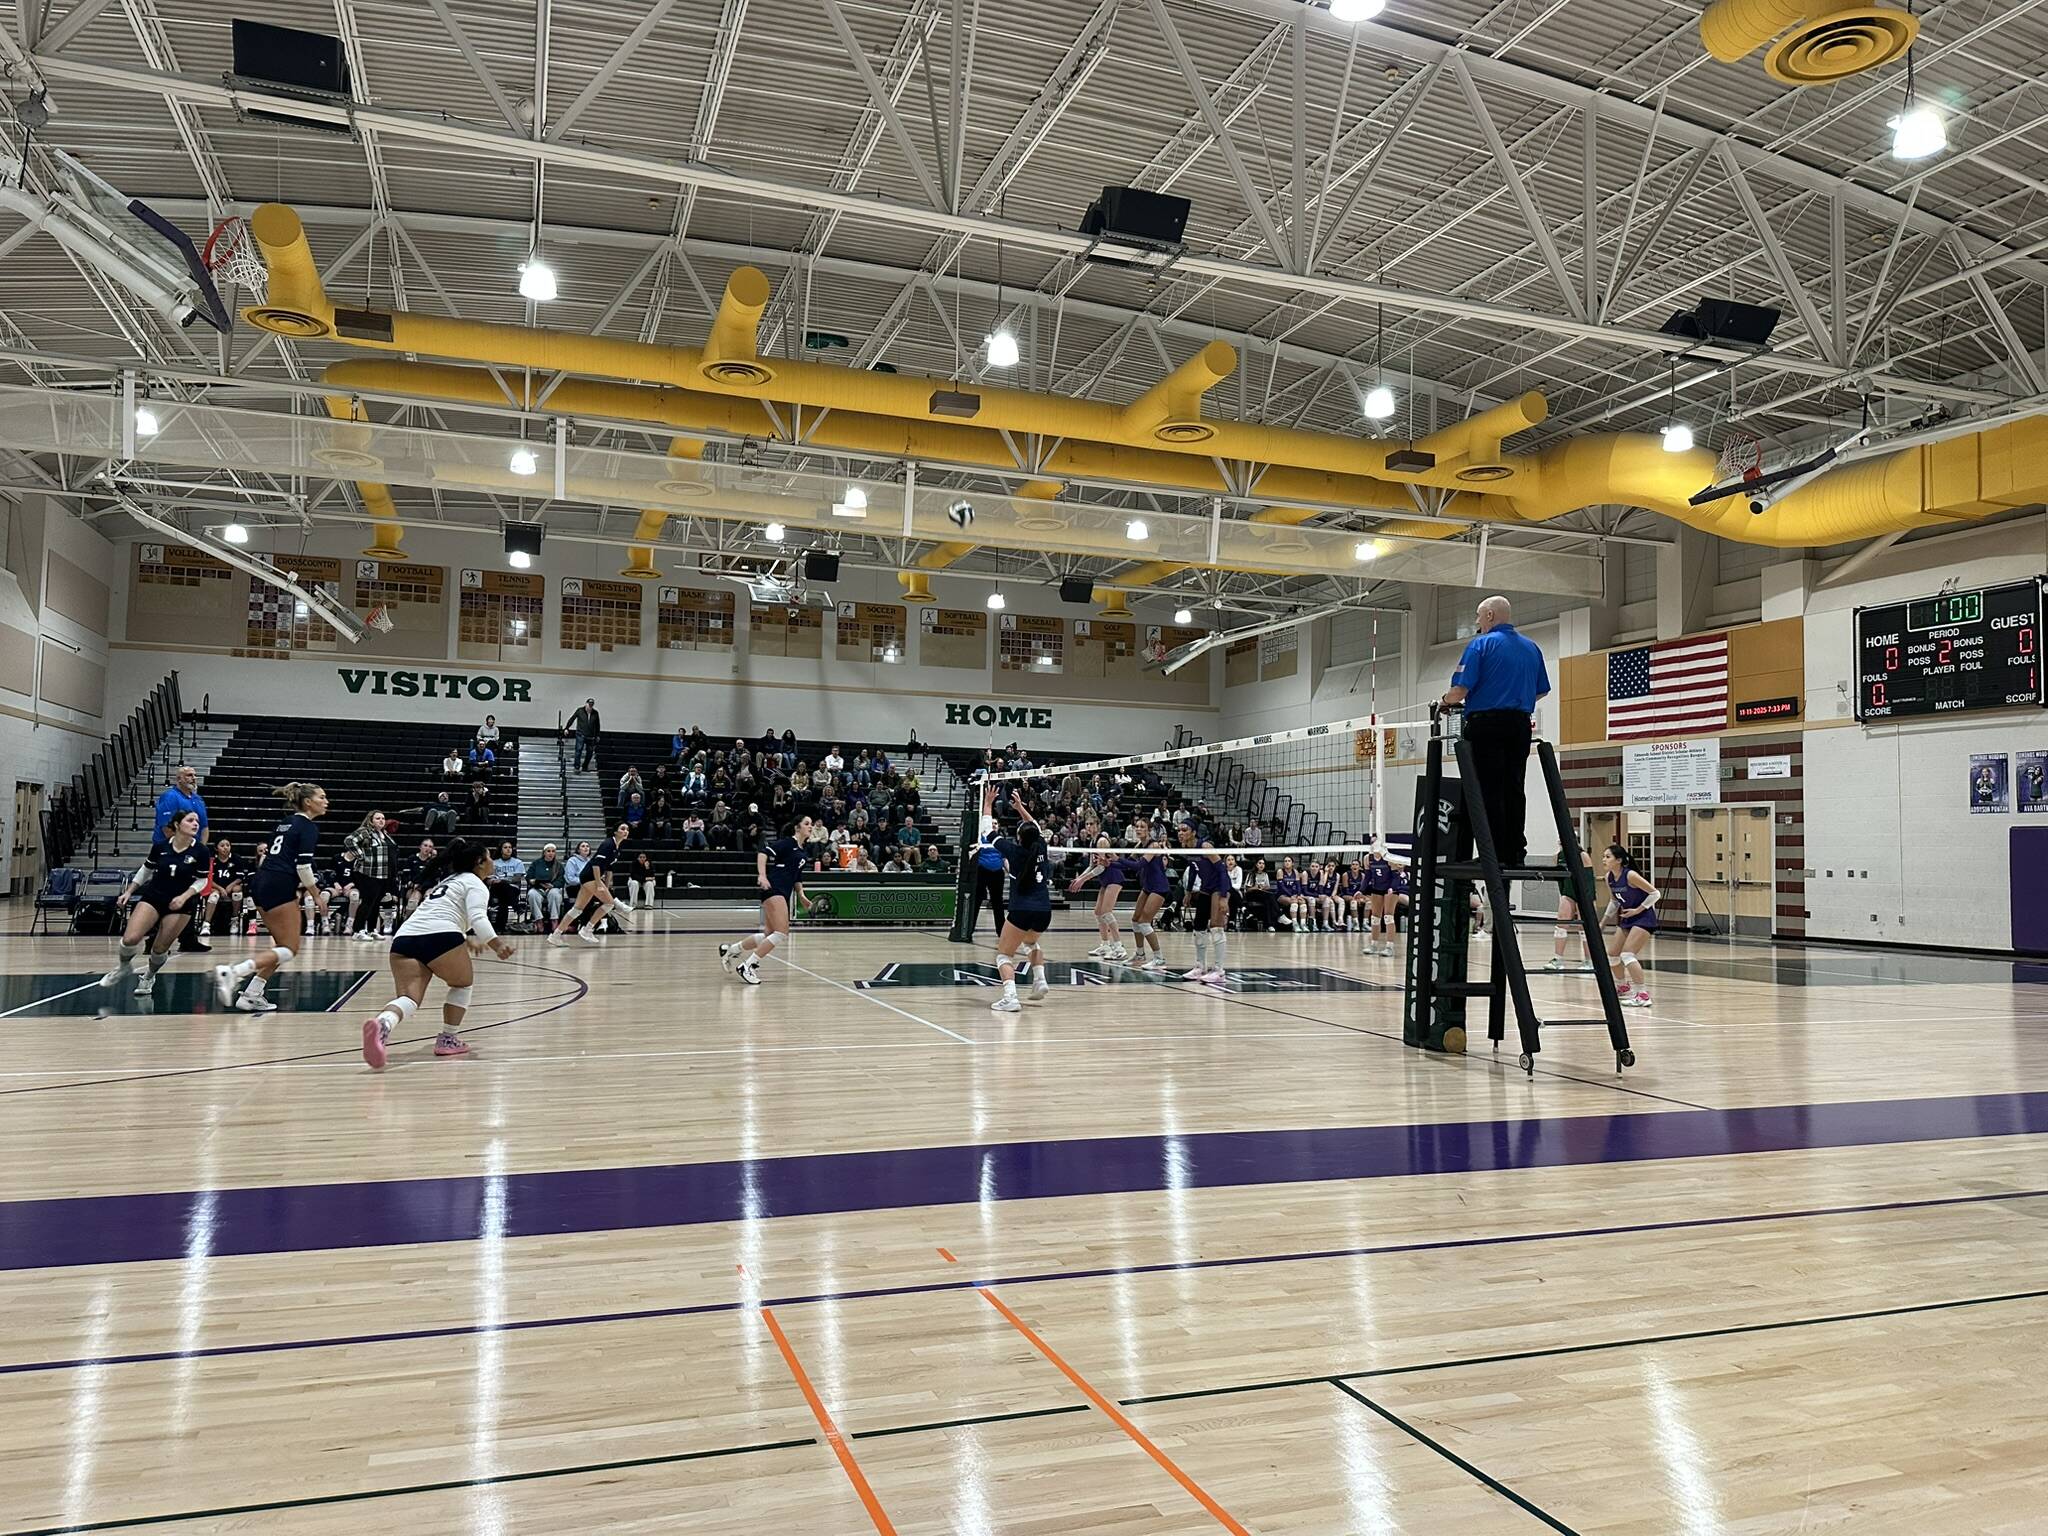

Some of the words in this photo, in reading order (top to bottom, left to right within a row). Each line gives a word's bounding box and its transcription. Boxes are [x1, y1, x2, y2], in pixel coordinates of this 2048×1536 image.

[387, 565, 434, 577] FOOTBALL
[497, 574, 531, 584] TENNIS
[587, 583, 638, 593] WRESTLING
[866, 605, 896, 615] SOCCER
[944, 612, 980, 621] SOFTBALL
[1022, 617, 1057, 627] BASEBALL
[1103, 623, 1121, 631] GOLF
[1928, 628, 1960, 639] PERIOD
[1865, 633, 1900, 648] HOME
[1953, 636, 1984, 648] BONUS
[2019, 628, 2033, 653] 0
[1907, 643, 1936, 654] BONUS
[1939, 639, 1951, 663] 2
[1886, 647, 1898, 670] 0
[1959, 649, 1984, 660] POSS
[1907, 656, 1931, 666] POSS
[1922, 664, 1955, 676] PLAYER
[1960, 662, 1984, 671] FOUL
[1862, 672, 1888, 683] FOULS
[338, 668, 532, 702] VISITOR
[1872, 683, 1885, 706] 0
[1781, 703, 1791, 711] PM
[1935, 699, 1965, 710] MATCH
[945, 703, 1053, 729] HOME
[1864, 706, 1892, 717] SCORE
[1307, 725, 1329, 737] WARRIORS
[1253, 735, 1272, 745] WARRIORS
[1651, 742, 1688, 751] SPONSORS
[270, 834, 284, 855] 8
[217, 869, 231, 878] 14
[343, 867, 351, 877] 5
[1375, 868, 1383, 877] 2
[857, 892, 942, 903] EDMONDS
[853, 904, 946, 916] WOODWAY
